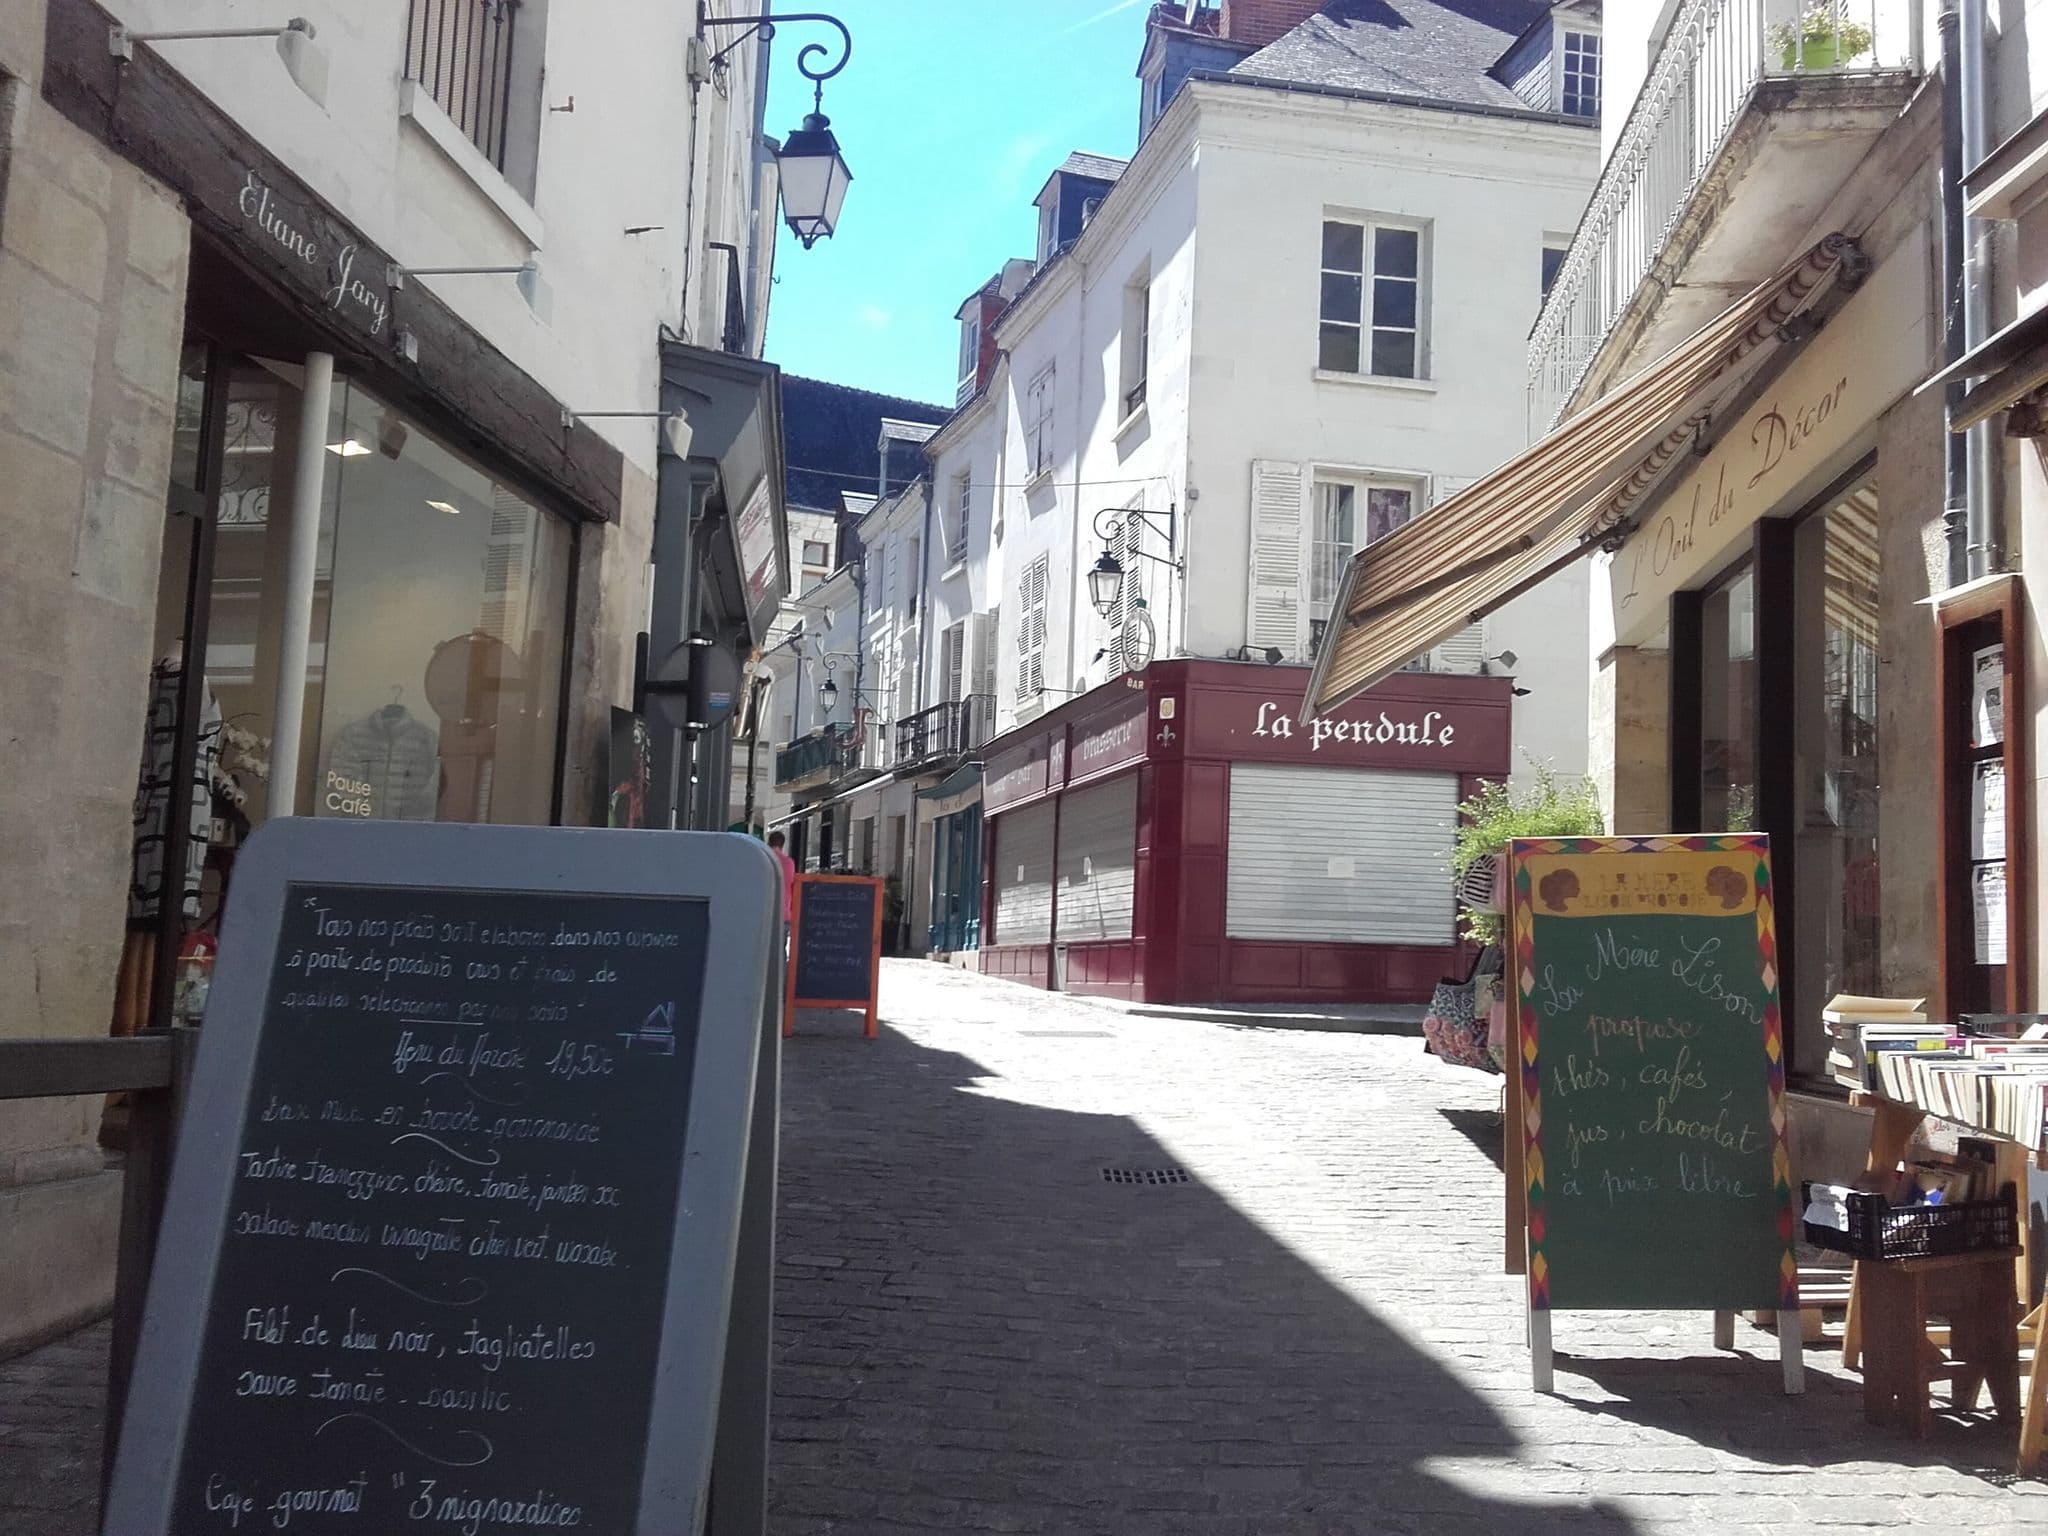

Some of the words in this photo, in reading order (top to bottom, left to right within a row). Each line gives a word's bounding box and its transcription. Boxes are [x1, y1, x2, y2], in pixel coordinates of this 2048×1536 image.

[239, 169, 318, 264] Eliane
[325, 245, 388, 335] Jary
[1709, 463, 1734, 527] du
[1748, 376, 1848, 489] Décor
[1127, 677, 1144, 690] BAR
[1252, 702, 1292, 739] La
[326, 792, 371, 816] Café
[327, 770, 371, 796] Pause
[1543, 964, 1583, 1017] La
[1587, 927, 1662, 982] Mère
[1672, 934, 1762, 1025] Lison
[1584, 1014, 1699, 1056] propose
[1639, 1095, 1757, 1154] chocolat
[1562, 1173, 1582, 1196] à
[1679, 1151, 1758, 1198] libre
[294, 1314, 329, 1345] de
[457, 1318, 596, 1371] tagliatelles
